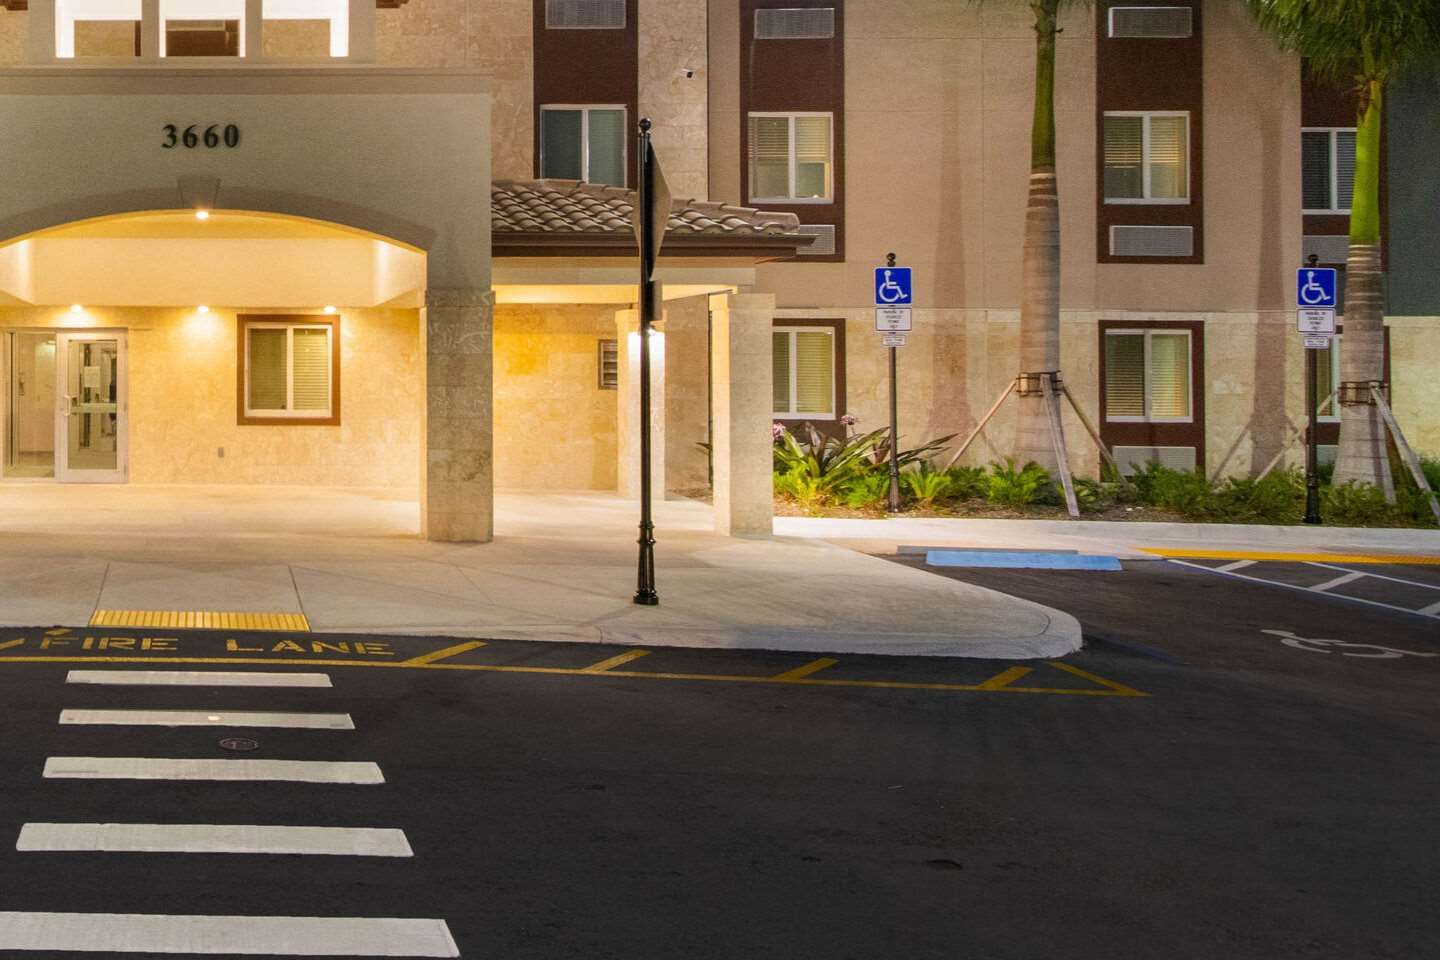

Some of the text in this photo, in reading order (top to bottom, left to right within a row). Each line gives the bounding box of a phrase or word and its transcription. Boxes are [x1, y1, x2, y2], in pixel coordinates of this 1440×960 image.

[161, 123, 240, 149] 3660
[39, 637, 395, 656] FIRE LANE
